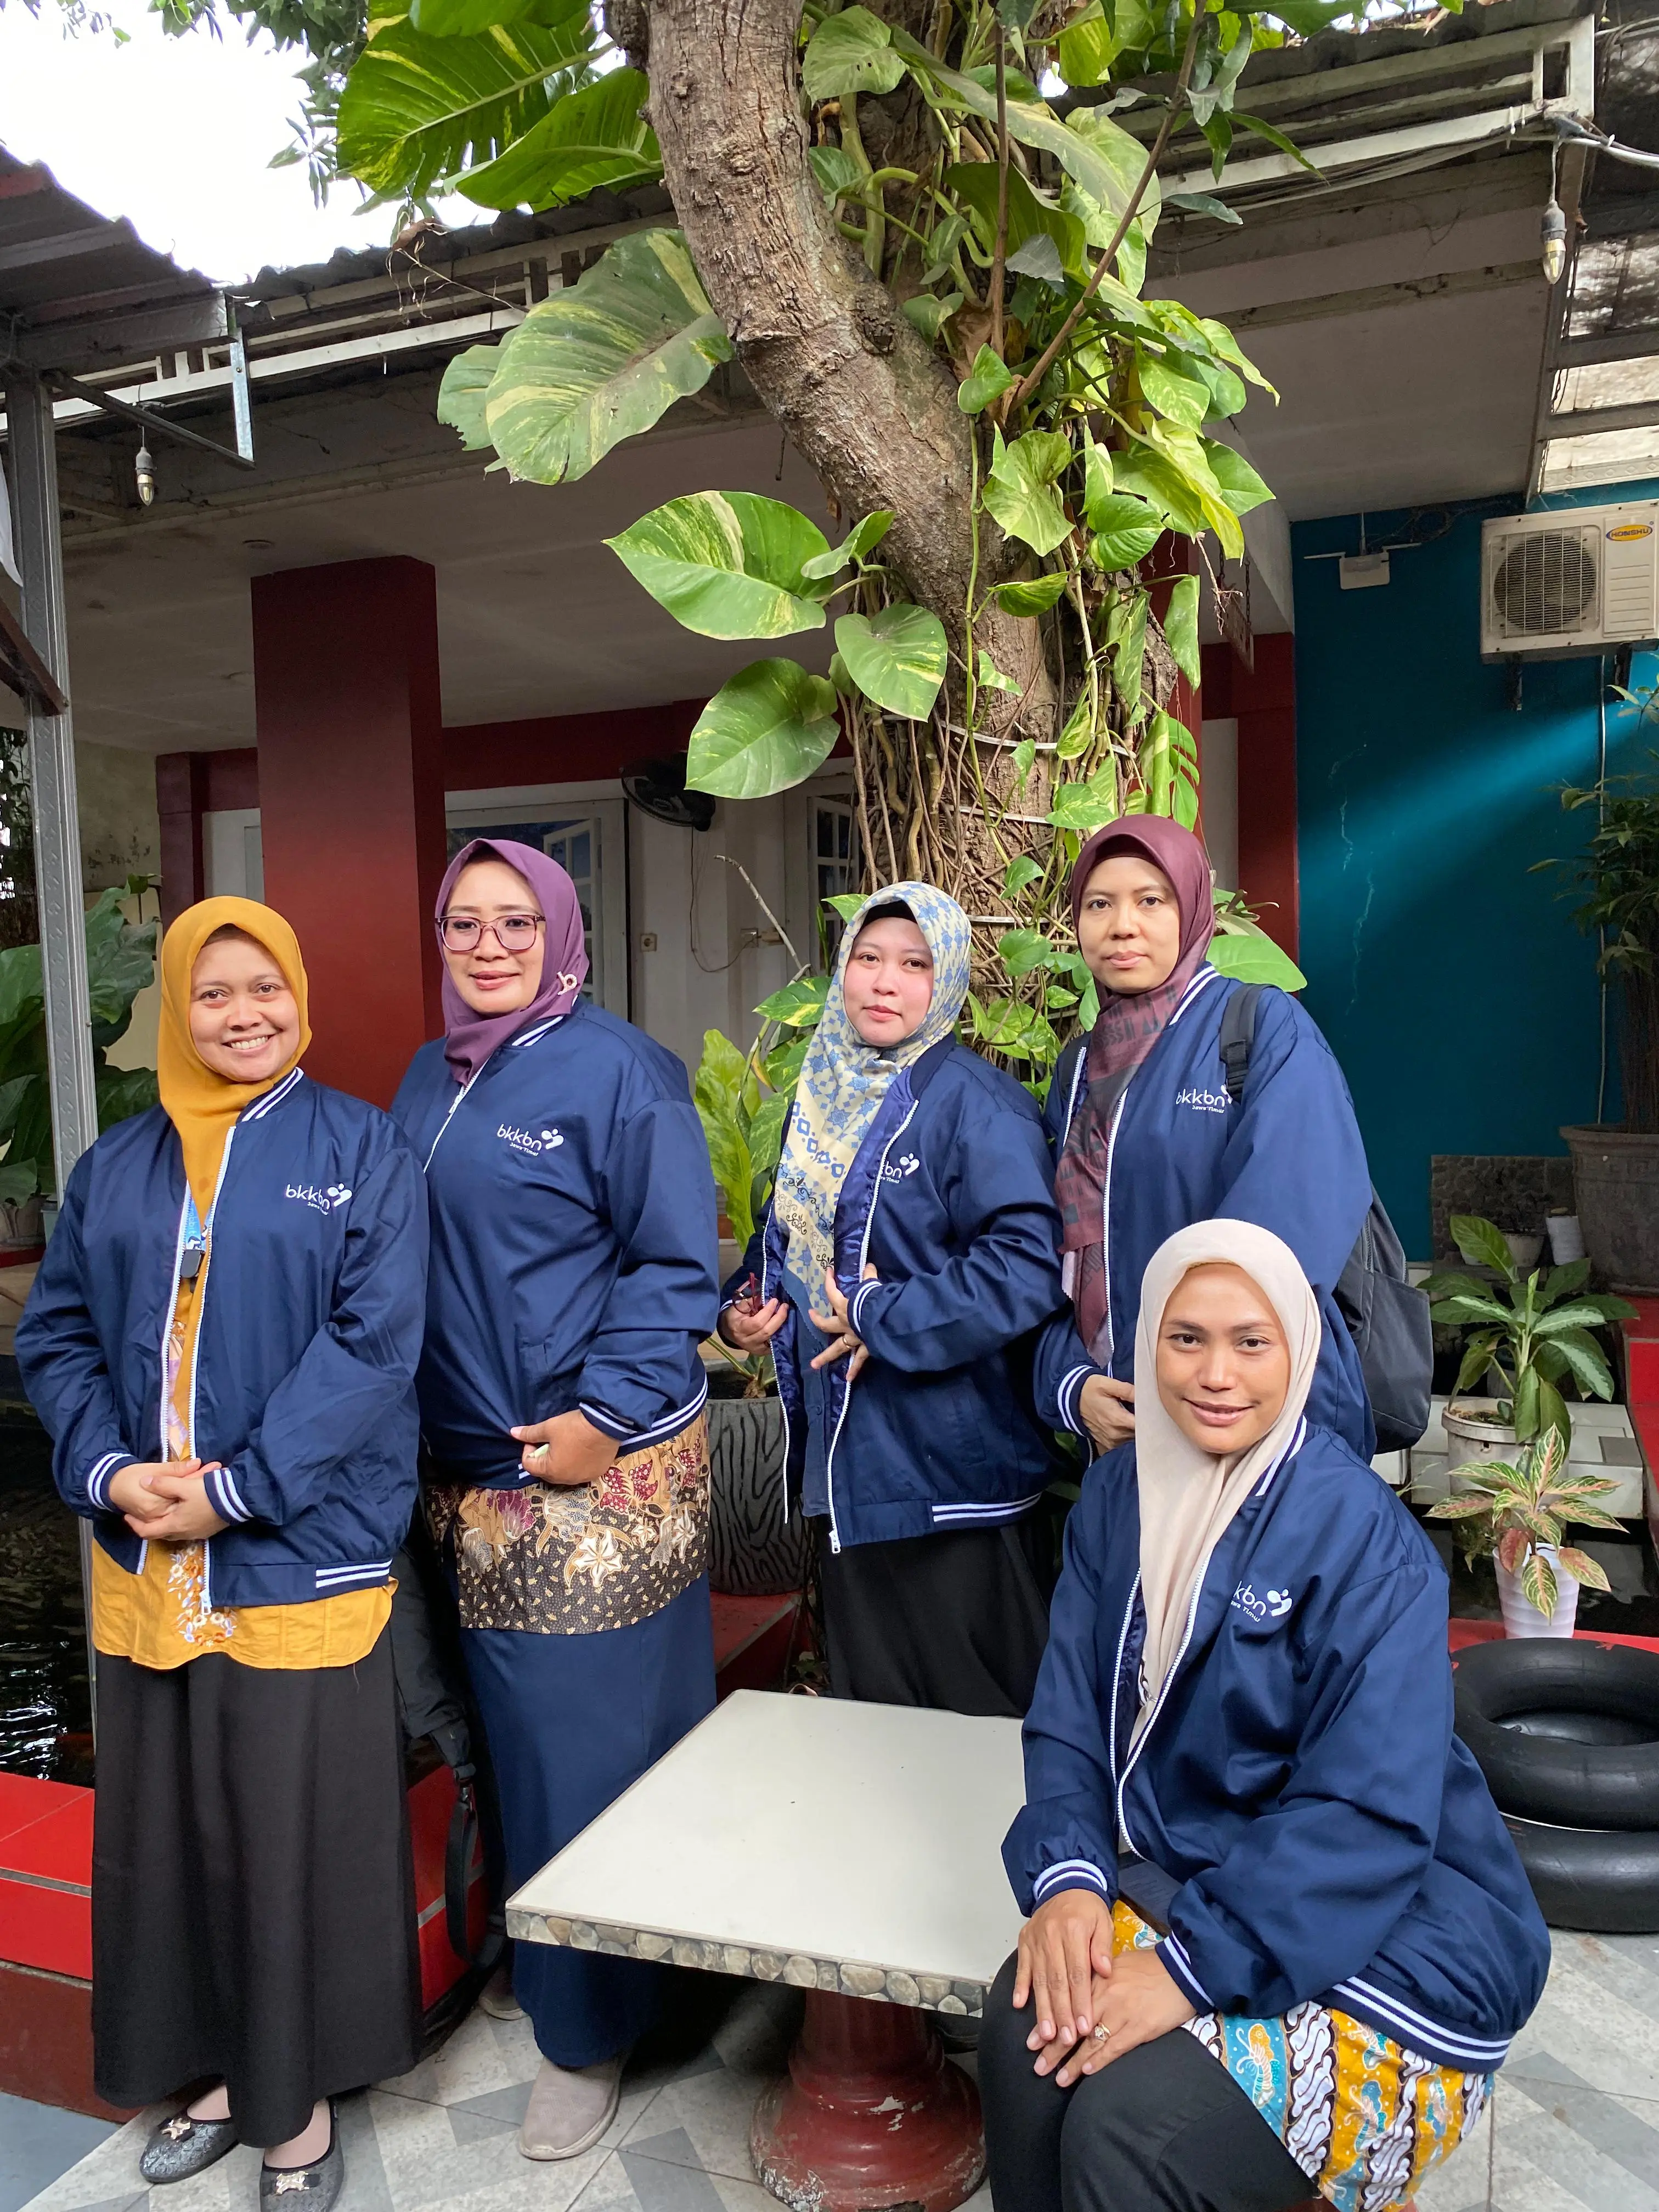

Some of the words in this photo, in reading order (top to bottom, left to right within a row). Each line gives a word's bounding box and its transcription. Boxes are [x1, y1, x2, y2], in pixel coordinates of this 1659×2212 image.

[1176, 1088, 1225, 1107] bkkbn
[496, 1124, 542, 1151] bkkbn
[285, 1184, 330, 1210] bkkbn
[1233, 1580, 1267, 1616] kbn
